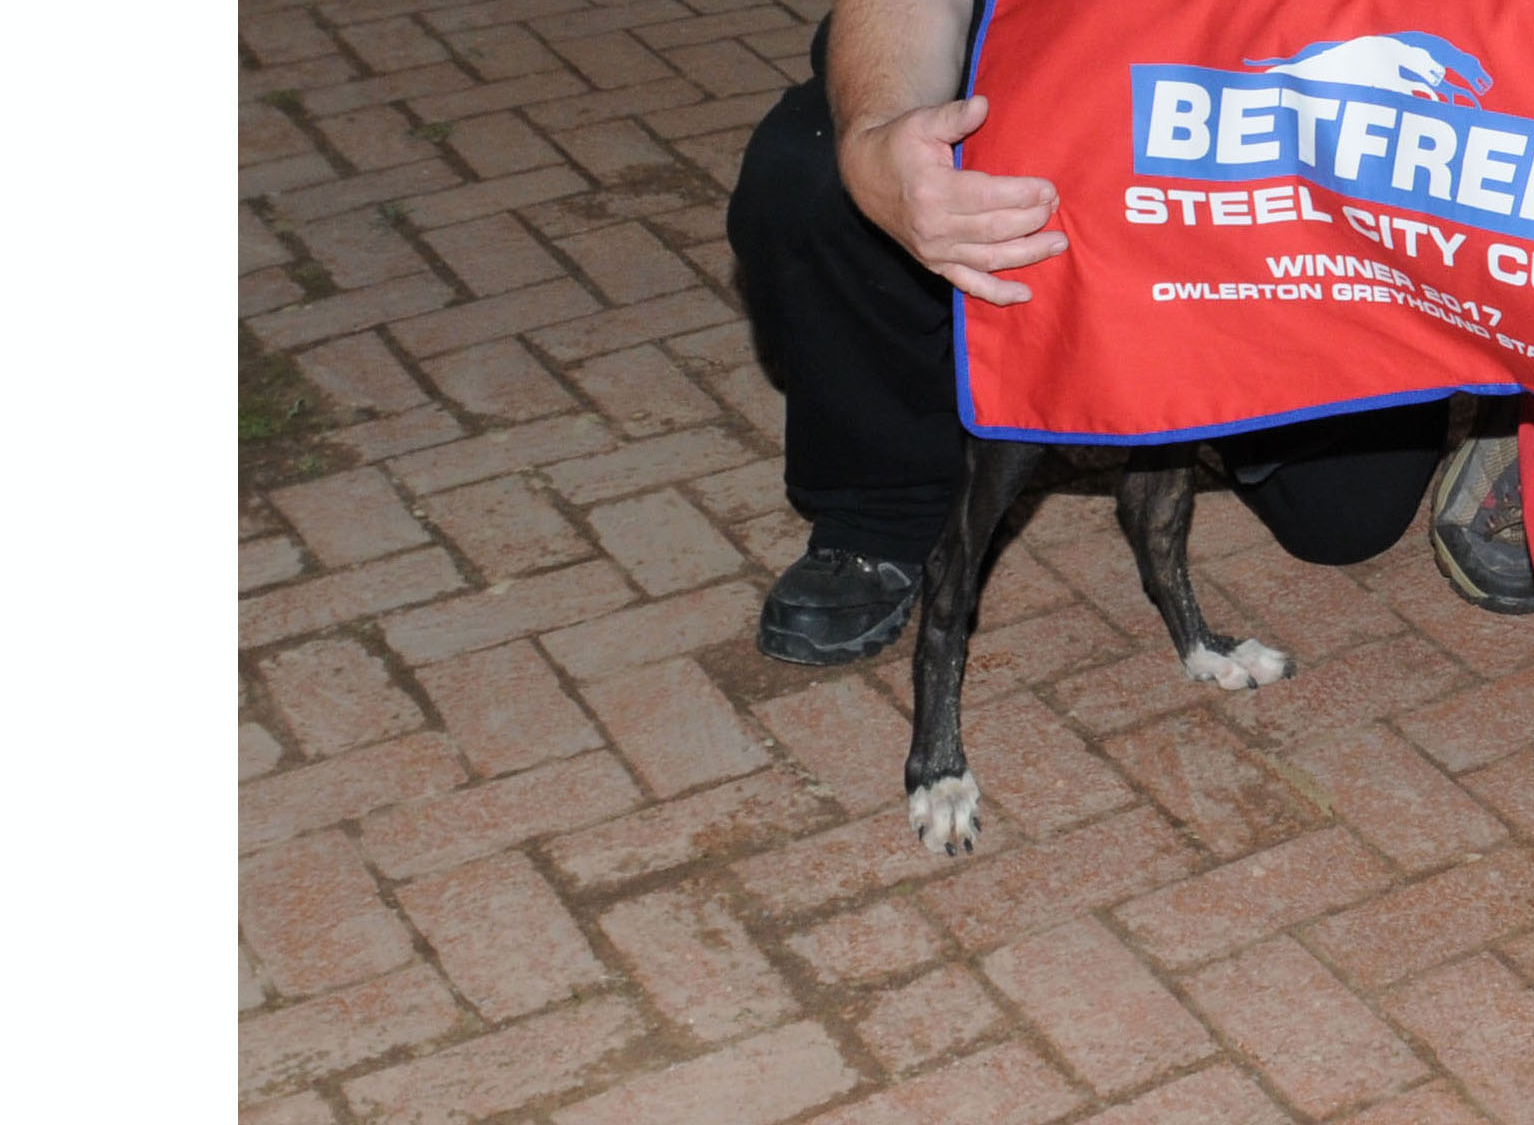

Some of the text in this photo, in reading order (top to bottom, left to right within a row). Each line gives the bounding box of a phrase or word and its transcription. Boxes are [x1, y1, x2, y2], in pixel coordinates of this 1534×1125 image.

[1125, 186, 1332, 226] STEEL
[1342, 205, 1466, 267] CITY
[1152, 282, 1322, 302] OWLERTON
[1332, 283, 1491, 339] GREYHOUND
[1266, 255, 1502, 327] WINNER 2017
